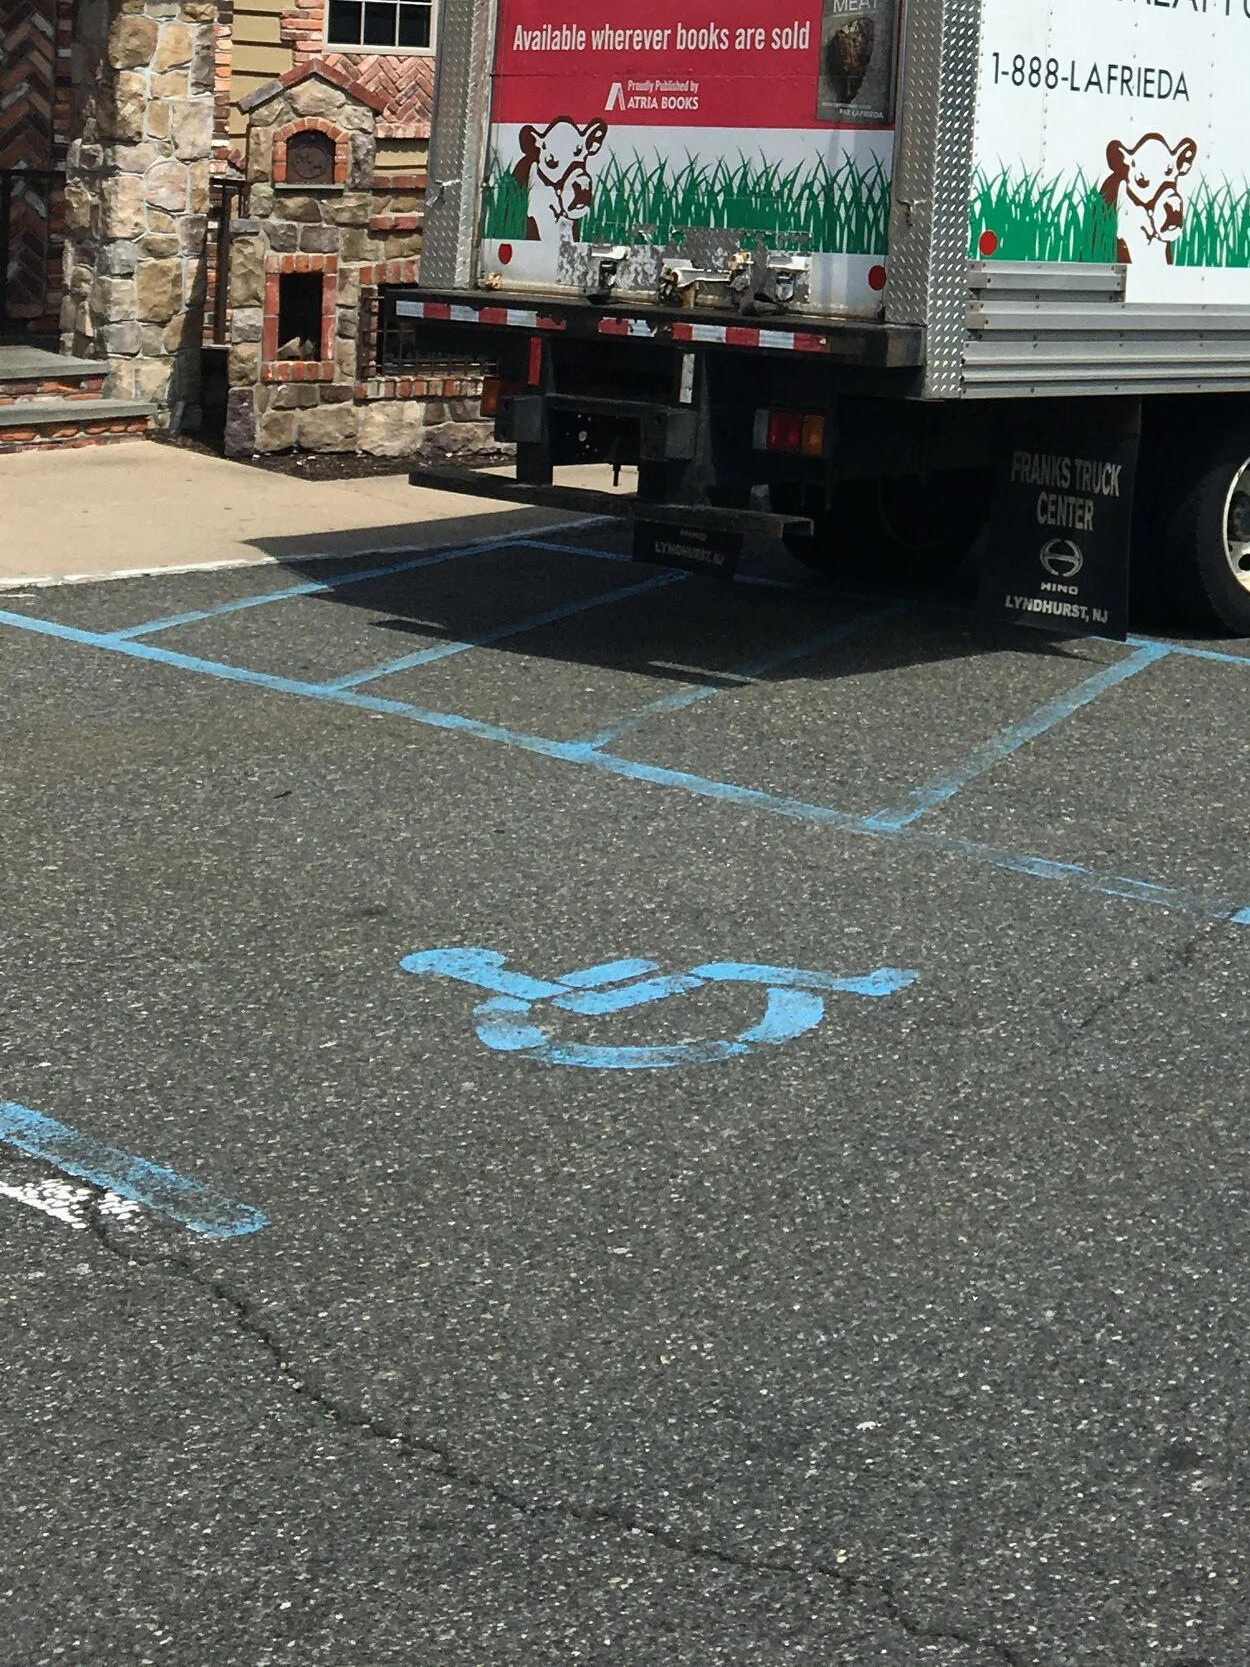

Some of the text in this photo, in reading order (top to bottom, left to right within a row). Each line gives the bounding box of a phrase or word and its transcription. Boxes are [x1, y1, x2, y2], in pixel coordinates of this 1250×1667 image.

[512, 21, 811, 52] Available wherever books are sold
[627, 79, 700, 94] Proudly Published by
[991, 51, 1191, 102] 1-888-LAFRIEDA
[627, 96, 700, 110] ATRIA BOOKS
[1010, 450, 1123, 498] FRANKS TRUCK
[1036, 491, 1094, 531] CENTER
[1040, 581, 1080, 596] HINO
[1004, 594, 1109, 624] LYNDHURST, NJ
